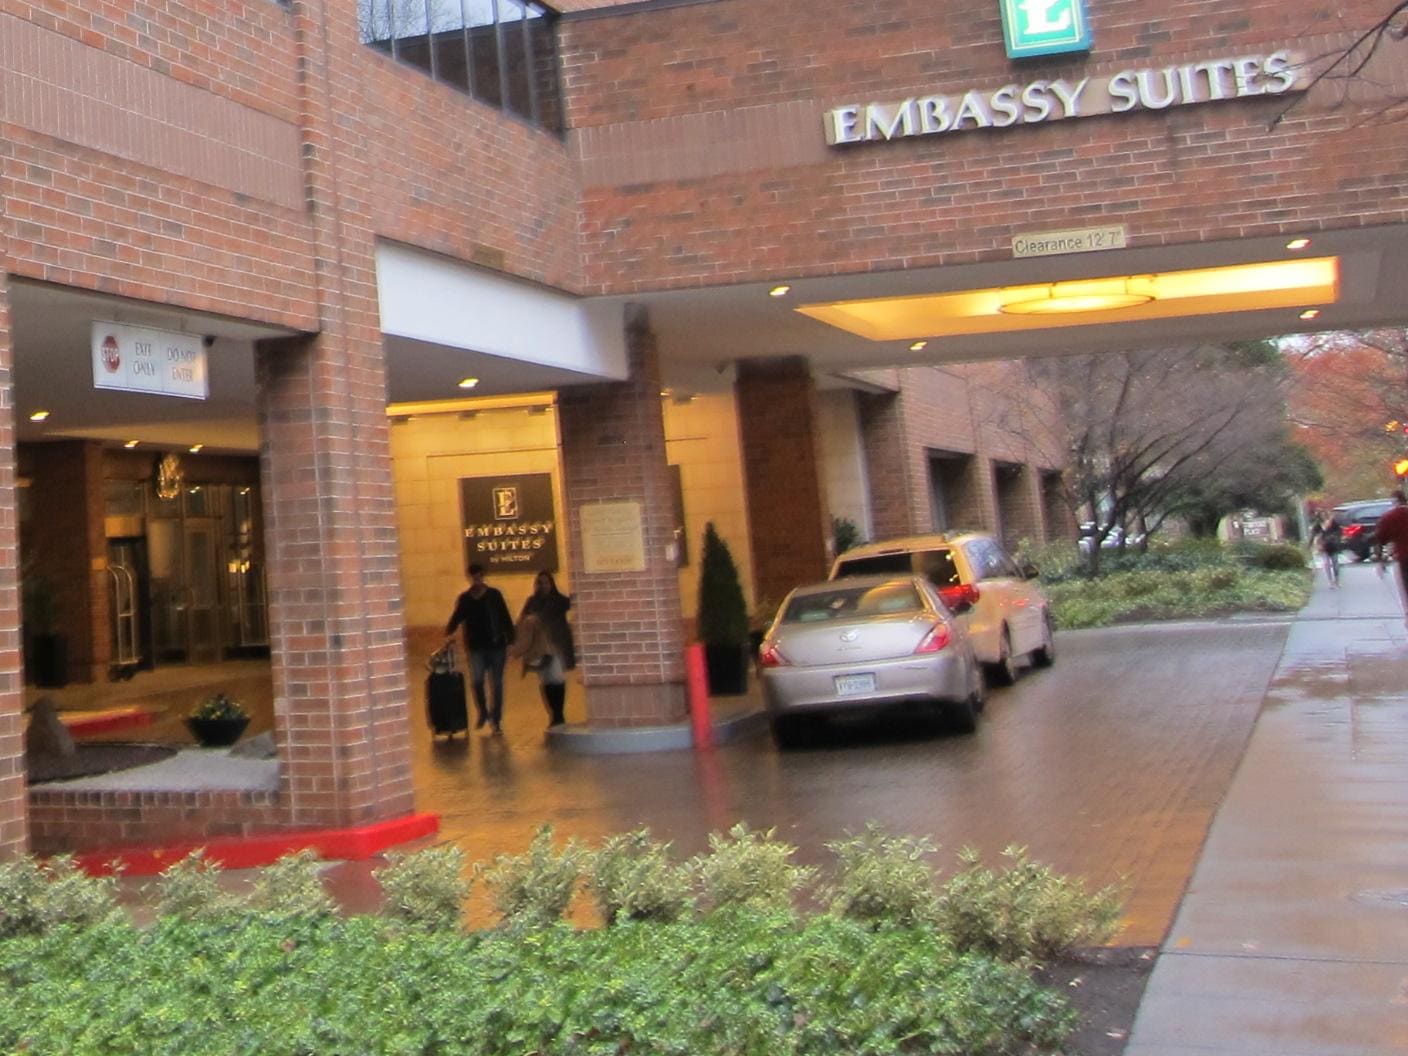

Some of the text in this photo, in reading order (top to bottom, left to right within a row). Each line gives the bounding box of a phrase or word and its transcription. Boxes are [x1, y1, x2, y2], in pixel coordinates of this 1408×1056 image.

[832, 50, 1296, 144] EMBASSY SUITES
[1015, 238, 1082, 254] Clearance
[464, 523, 553, 538] EMBASSY
[476, 539, 544, 552] SUITES
